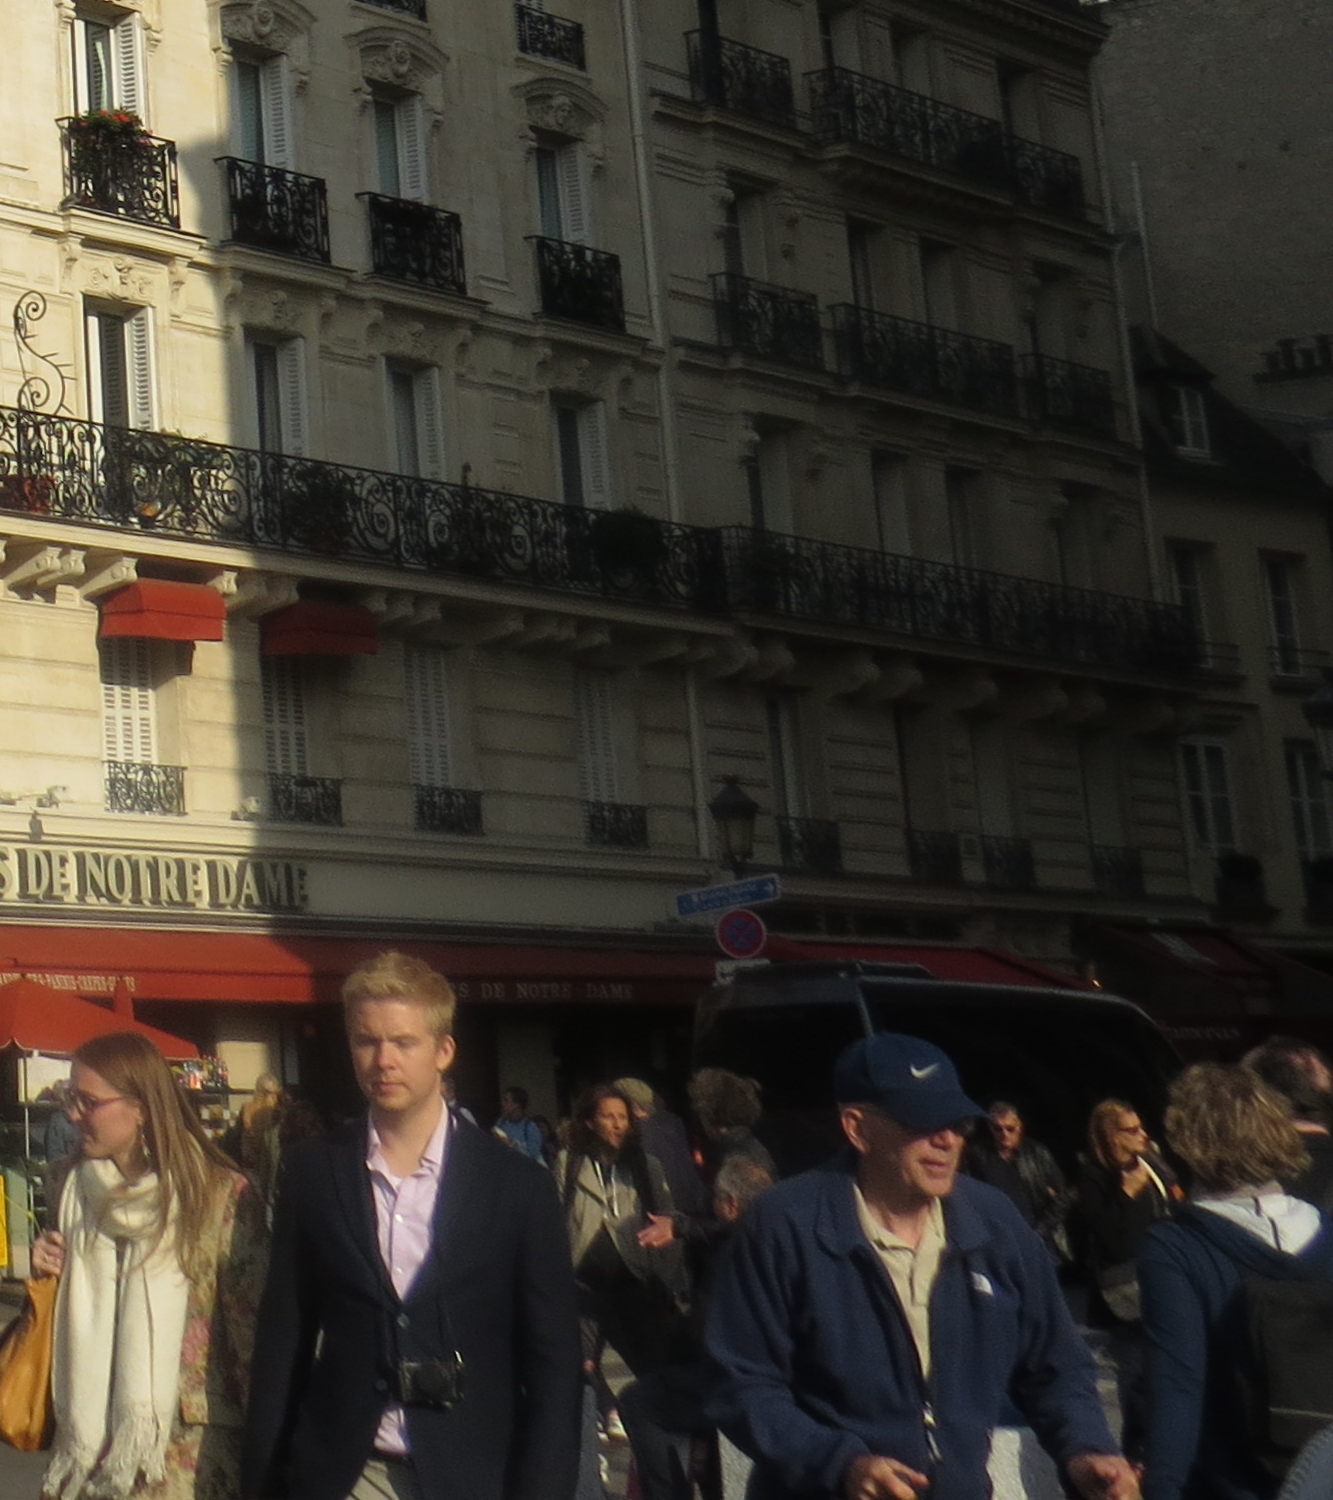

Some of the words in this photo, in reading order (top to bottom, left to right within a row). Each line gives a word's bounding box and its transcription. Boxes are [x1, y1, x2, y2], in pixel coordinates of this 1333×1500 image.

[25, 848, 72, 897] DE
[83, 850, 201, 902] NOTRE
[215, 858, 309, 908] DAME
